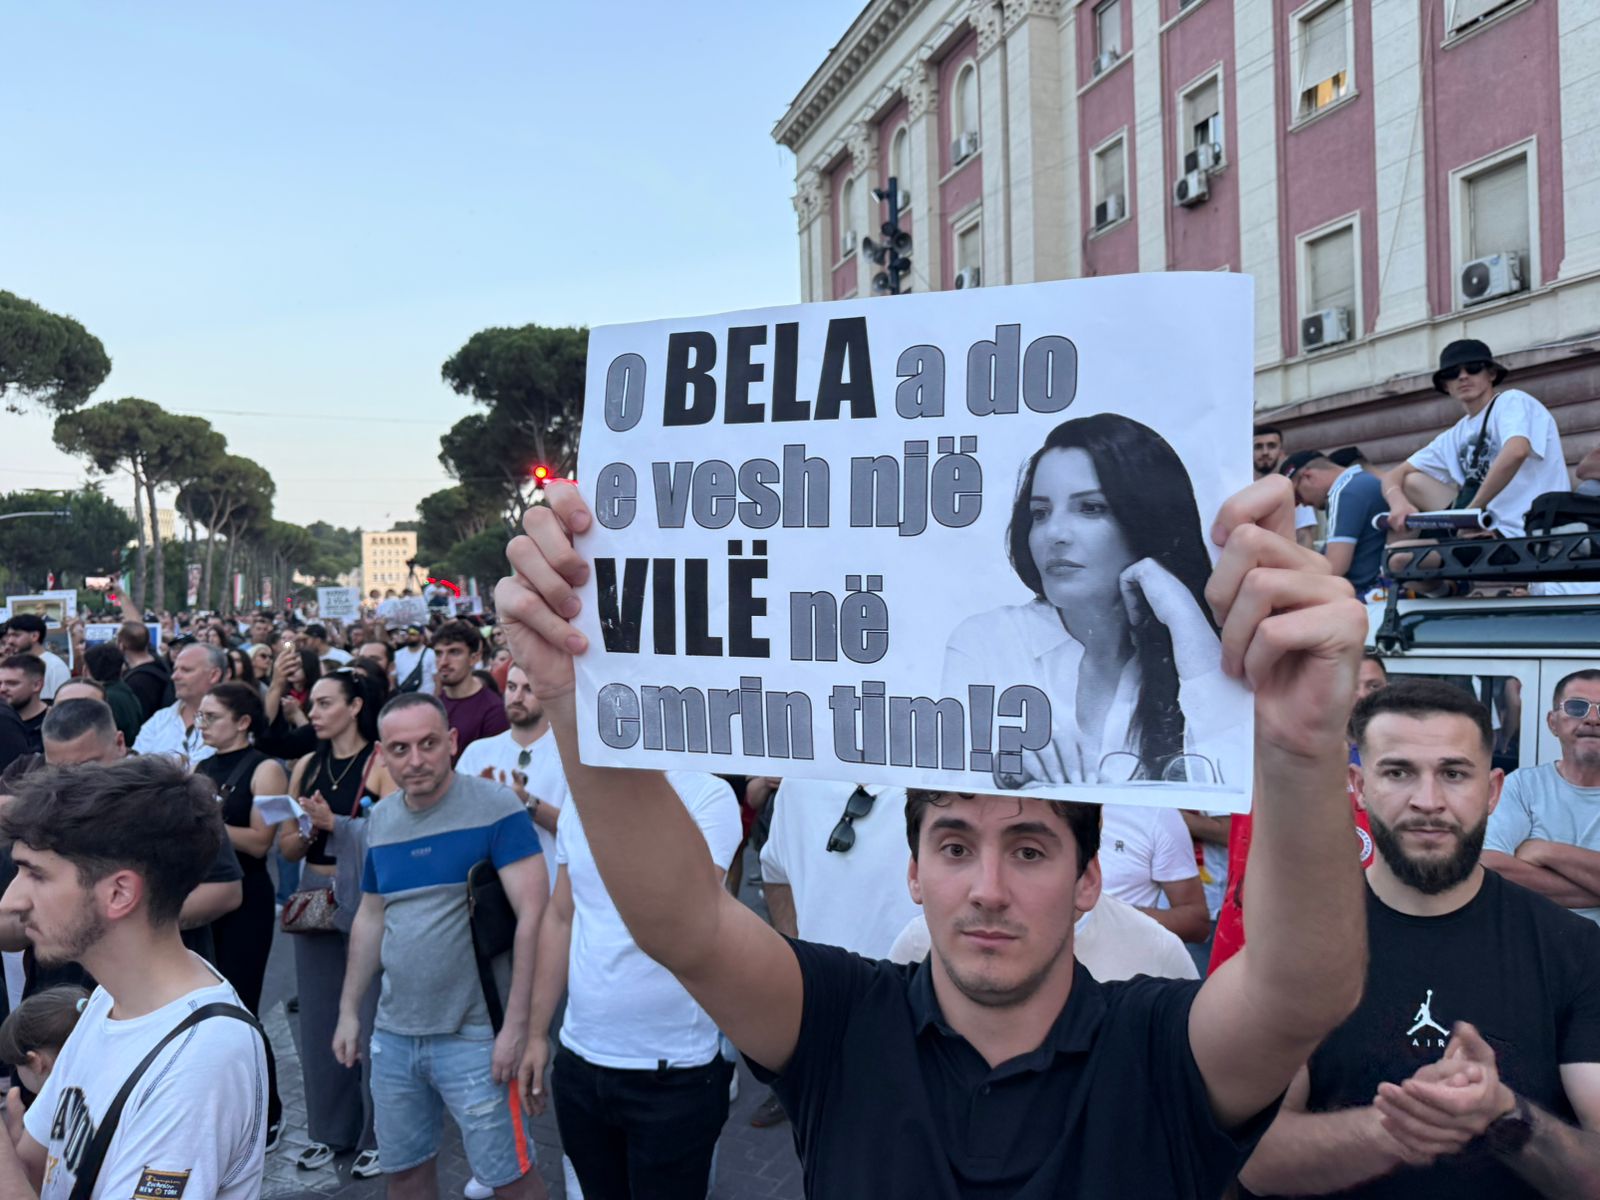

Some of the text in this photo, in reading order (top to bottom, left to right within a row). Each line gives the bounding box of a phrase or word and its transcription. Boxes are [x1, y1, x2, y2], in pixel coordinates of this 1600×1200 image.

[604, 316, 1078, 432] o BELA a do
[595, 435, 983, 536] e vesh një
[594, 540, 889, 664] VILË në
[597, 676, 1052, 775] emrin tim!?
[1412, 1038, 1445, 1048] AIR
